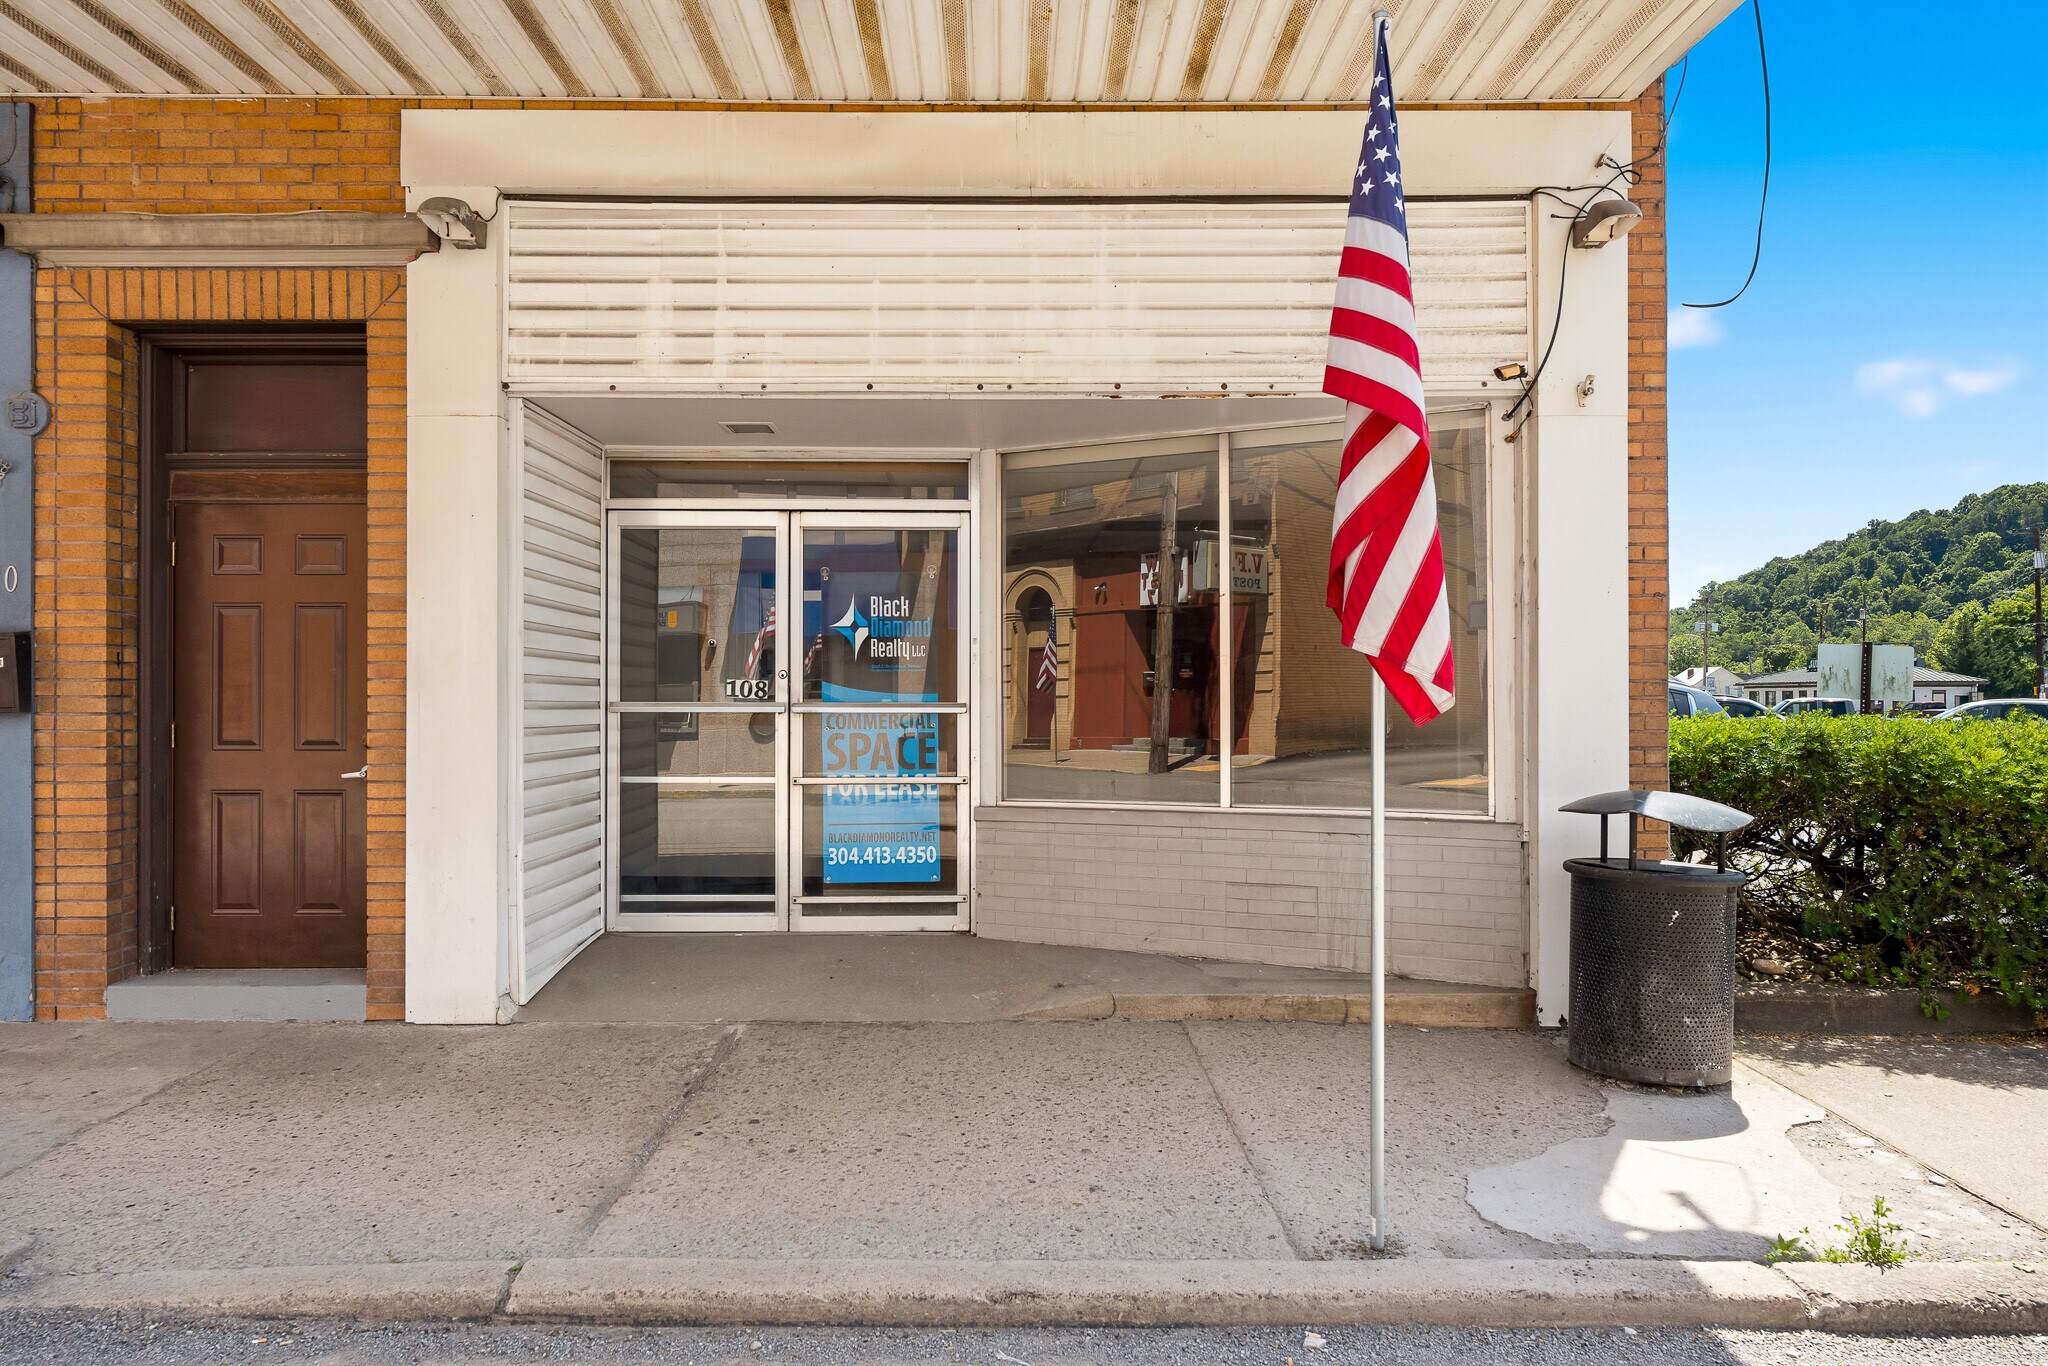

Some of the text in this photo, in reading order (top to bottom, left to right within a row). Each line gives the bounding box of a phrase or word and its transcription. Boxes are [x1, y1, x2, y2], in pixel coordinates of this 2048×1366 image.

[870, 595, 909, 617] Black
[870, 615, 932, 638] Diamond
[870, 638, 926, 661] Realty LLC
[726, 680, 768, 698] 108
[825, 712, 936, 730] COMMERCIAL
[826, 732, 937, 770] SPACE
[826, 774, 938, 797] FOR LEASE
[828, 831, 937, 844] BLACKDIAMONDREALTY.NET
[827, 845, 938, 865] 304.413.4350
